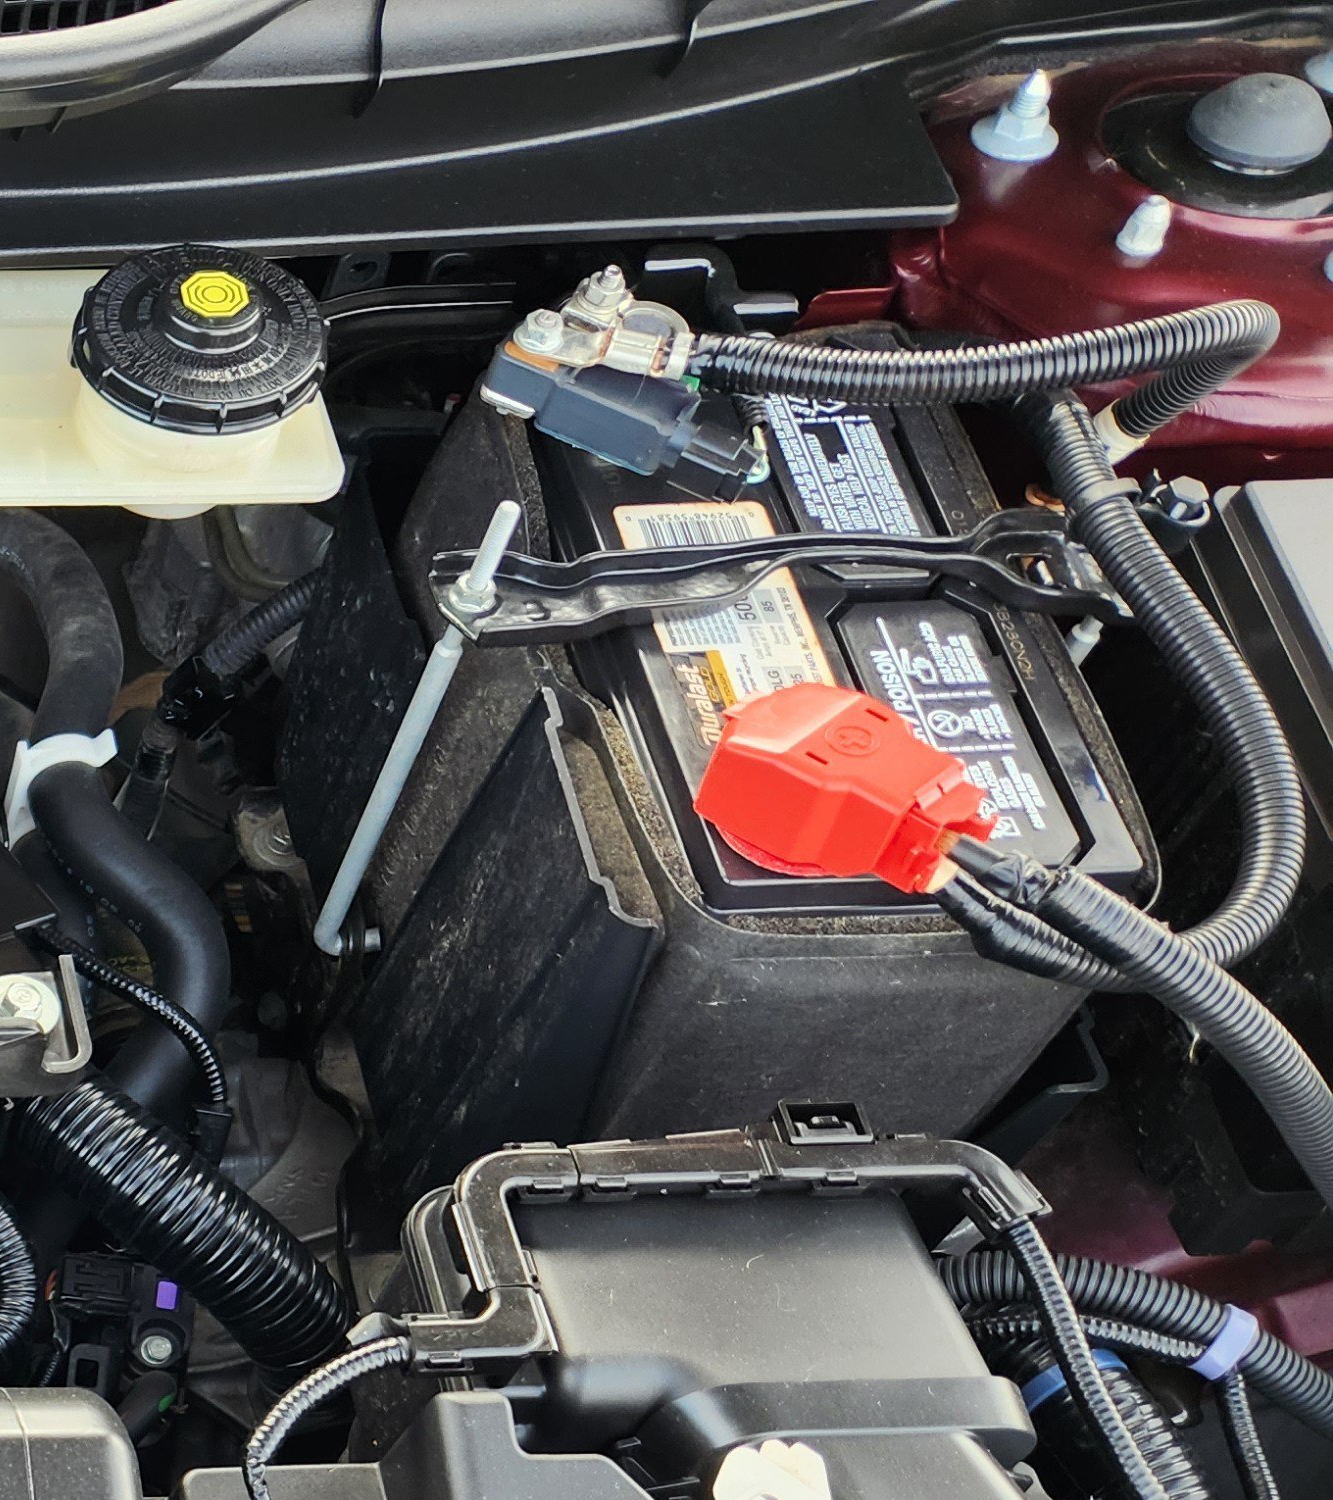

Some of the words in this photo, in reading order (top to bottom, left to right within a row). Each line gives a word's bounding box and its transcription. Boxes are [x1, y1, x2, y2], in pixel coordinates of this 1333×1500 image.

[803, 433, 834, 482] IMMEDIATELY
[824, 484, 842, 503] EYES
[845, 474, 863, 494] HELP
[833, 505, 853, 529] FLUSH
[848, 509, 866, 529] WITH
[855, 496, 878, 529] MEDICAL
[760, 600, 774, 611] 85
[699, 665, 719, 703] GOLD
[869, 649, 913, 710] POISON
